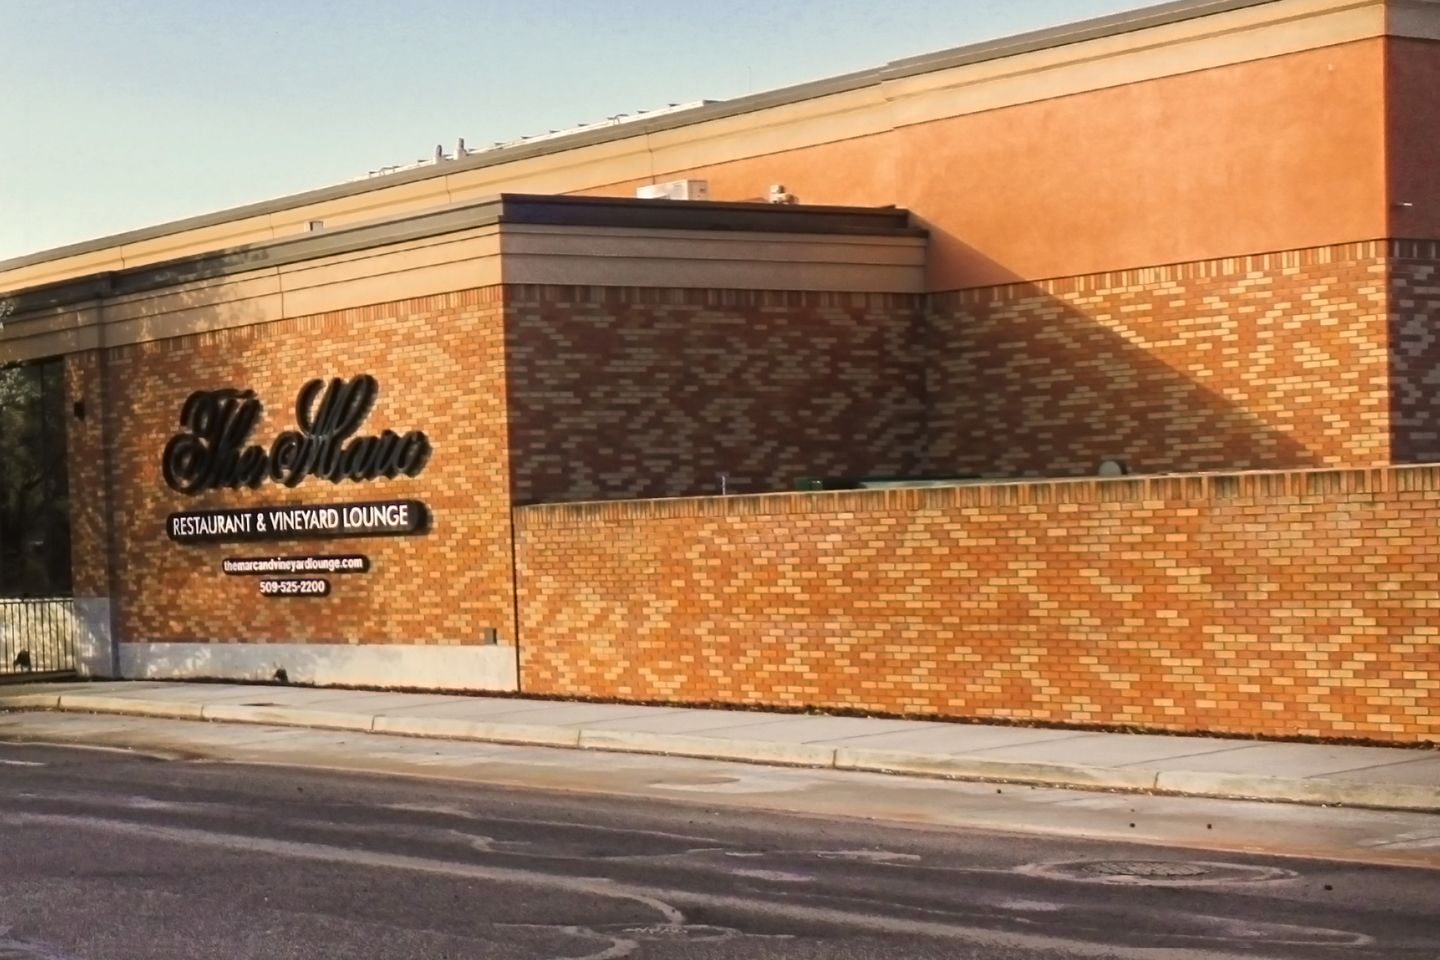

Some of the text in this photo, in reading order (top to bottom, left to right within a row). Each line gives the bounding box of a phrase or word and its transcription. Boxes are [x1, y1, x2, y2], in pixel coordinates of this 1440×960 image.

[163, 374, 433, 496] The Marc
[173, 504, 408, 536] RESTAURANT & VINEYARD LOUNGE
[223, 556, 363, 572] themarcandvineyardlounge.com
[259, 580, 325, 594] 509-525-2200
